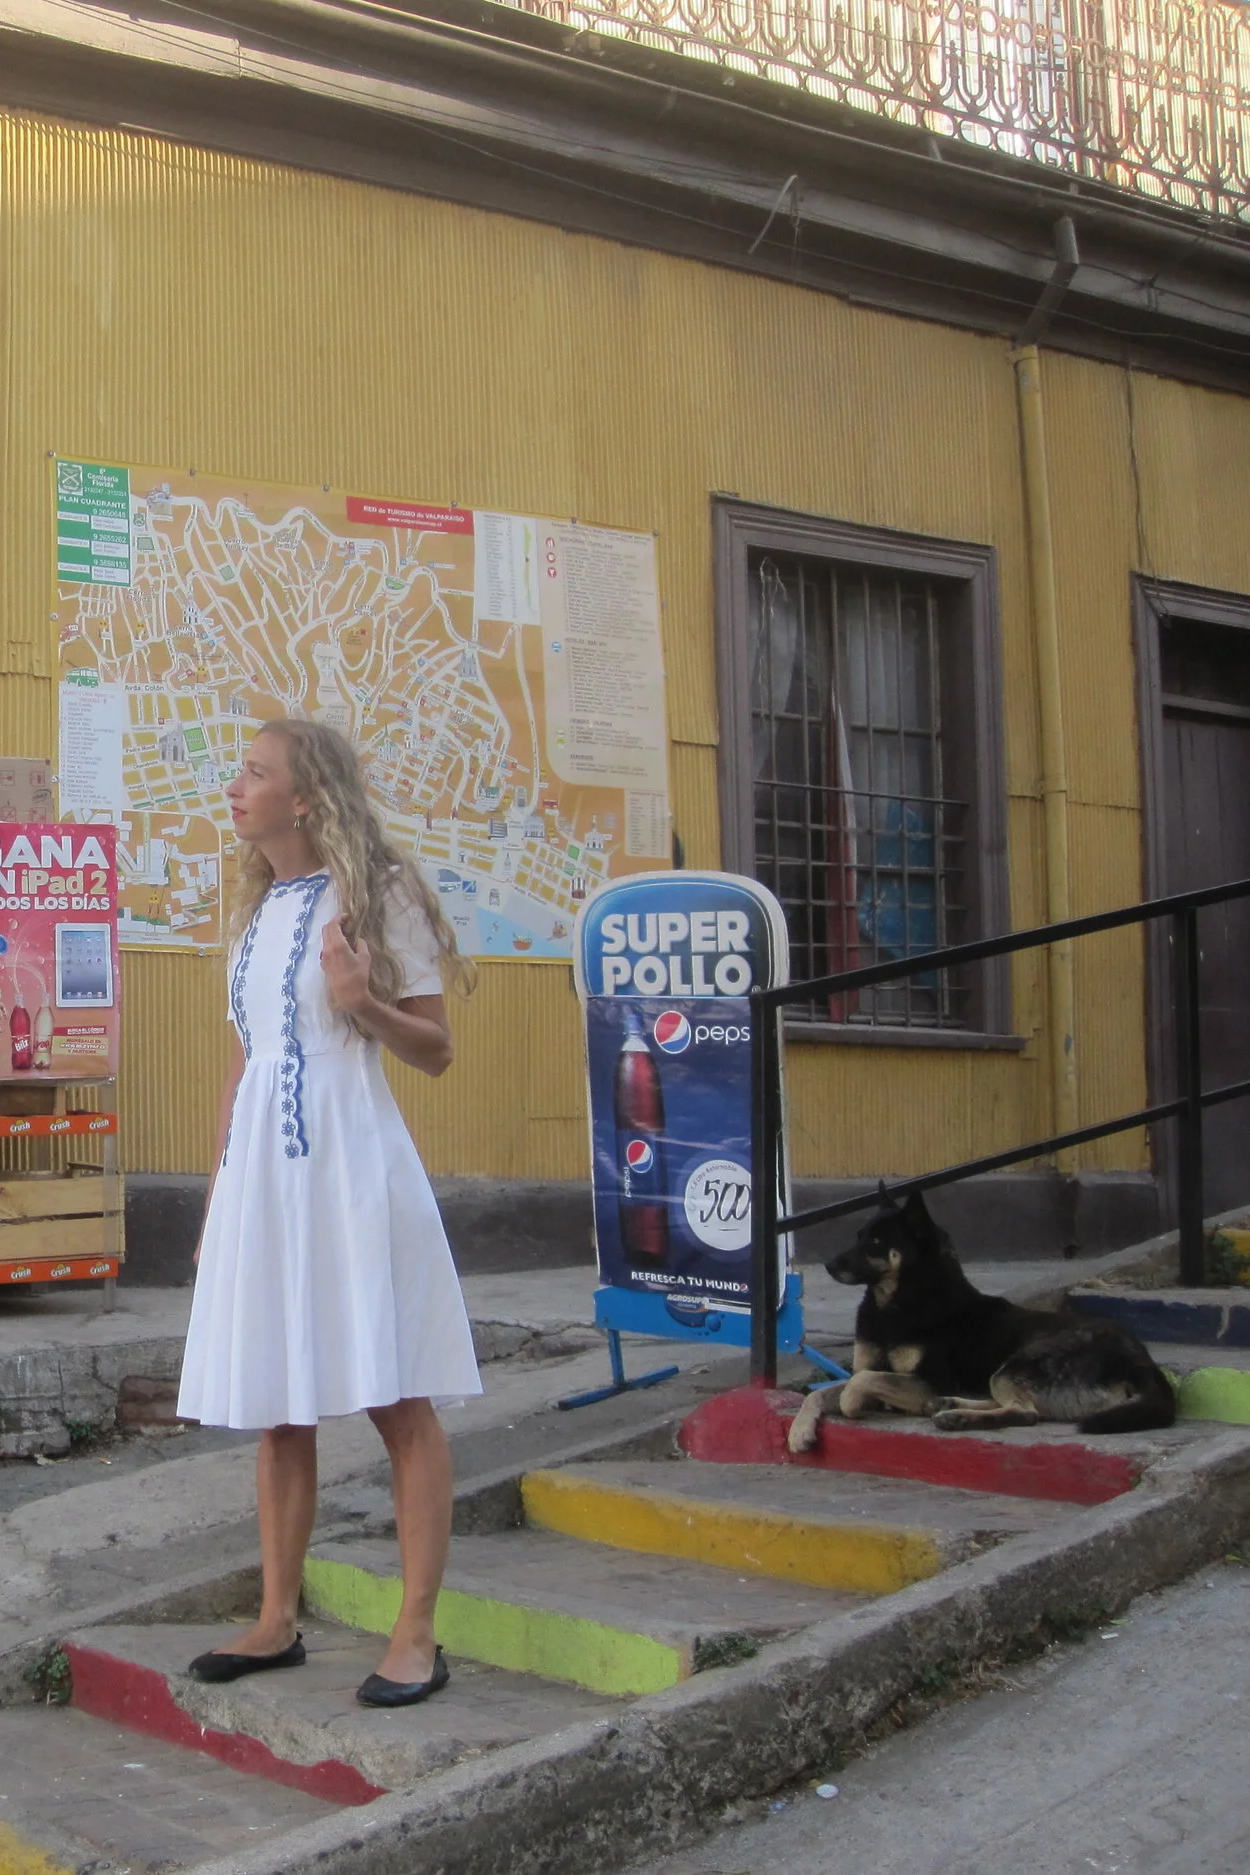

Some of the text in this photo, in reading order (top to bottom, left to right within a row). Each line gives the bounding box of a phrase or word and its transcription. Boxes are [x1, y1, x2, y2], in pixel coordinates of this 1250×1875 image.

[58, 495, 127, 510] PLAN CUADRANTE
[363, 505, 377, 513] RED
[387, 508, 416, 518] TURISMO
[144, 684, 165, 692] Colón
[21, 868, 84, 895] iPad
[90, 870, 108, 895] 2
[35, 896, 70, 911] LOS
[71, 893, 111, 911] DÍAS
[600, 910, 751, 955] SUPER
[601, 953, 753, 997] POLLO
[695, 1025, 751, 1046] peps
[9, 1120, 31, 1133] Crush
[50, 1119, 71, 1132] Crush
[89, 1117, 110, 1130] Crush
[623, 1166, 632, 1198] pepsi
[699, 1178, 752, 1224] 500
[10, 1267, 32, 1280] Crush
[51, 1265, 71, 1278] Crush
[90, 1263, 110, 1276] Crush
[631, 1270, 686, 1286] REFRESCA
[686, 1276, 703, 1287] TU
